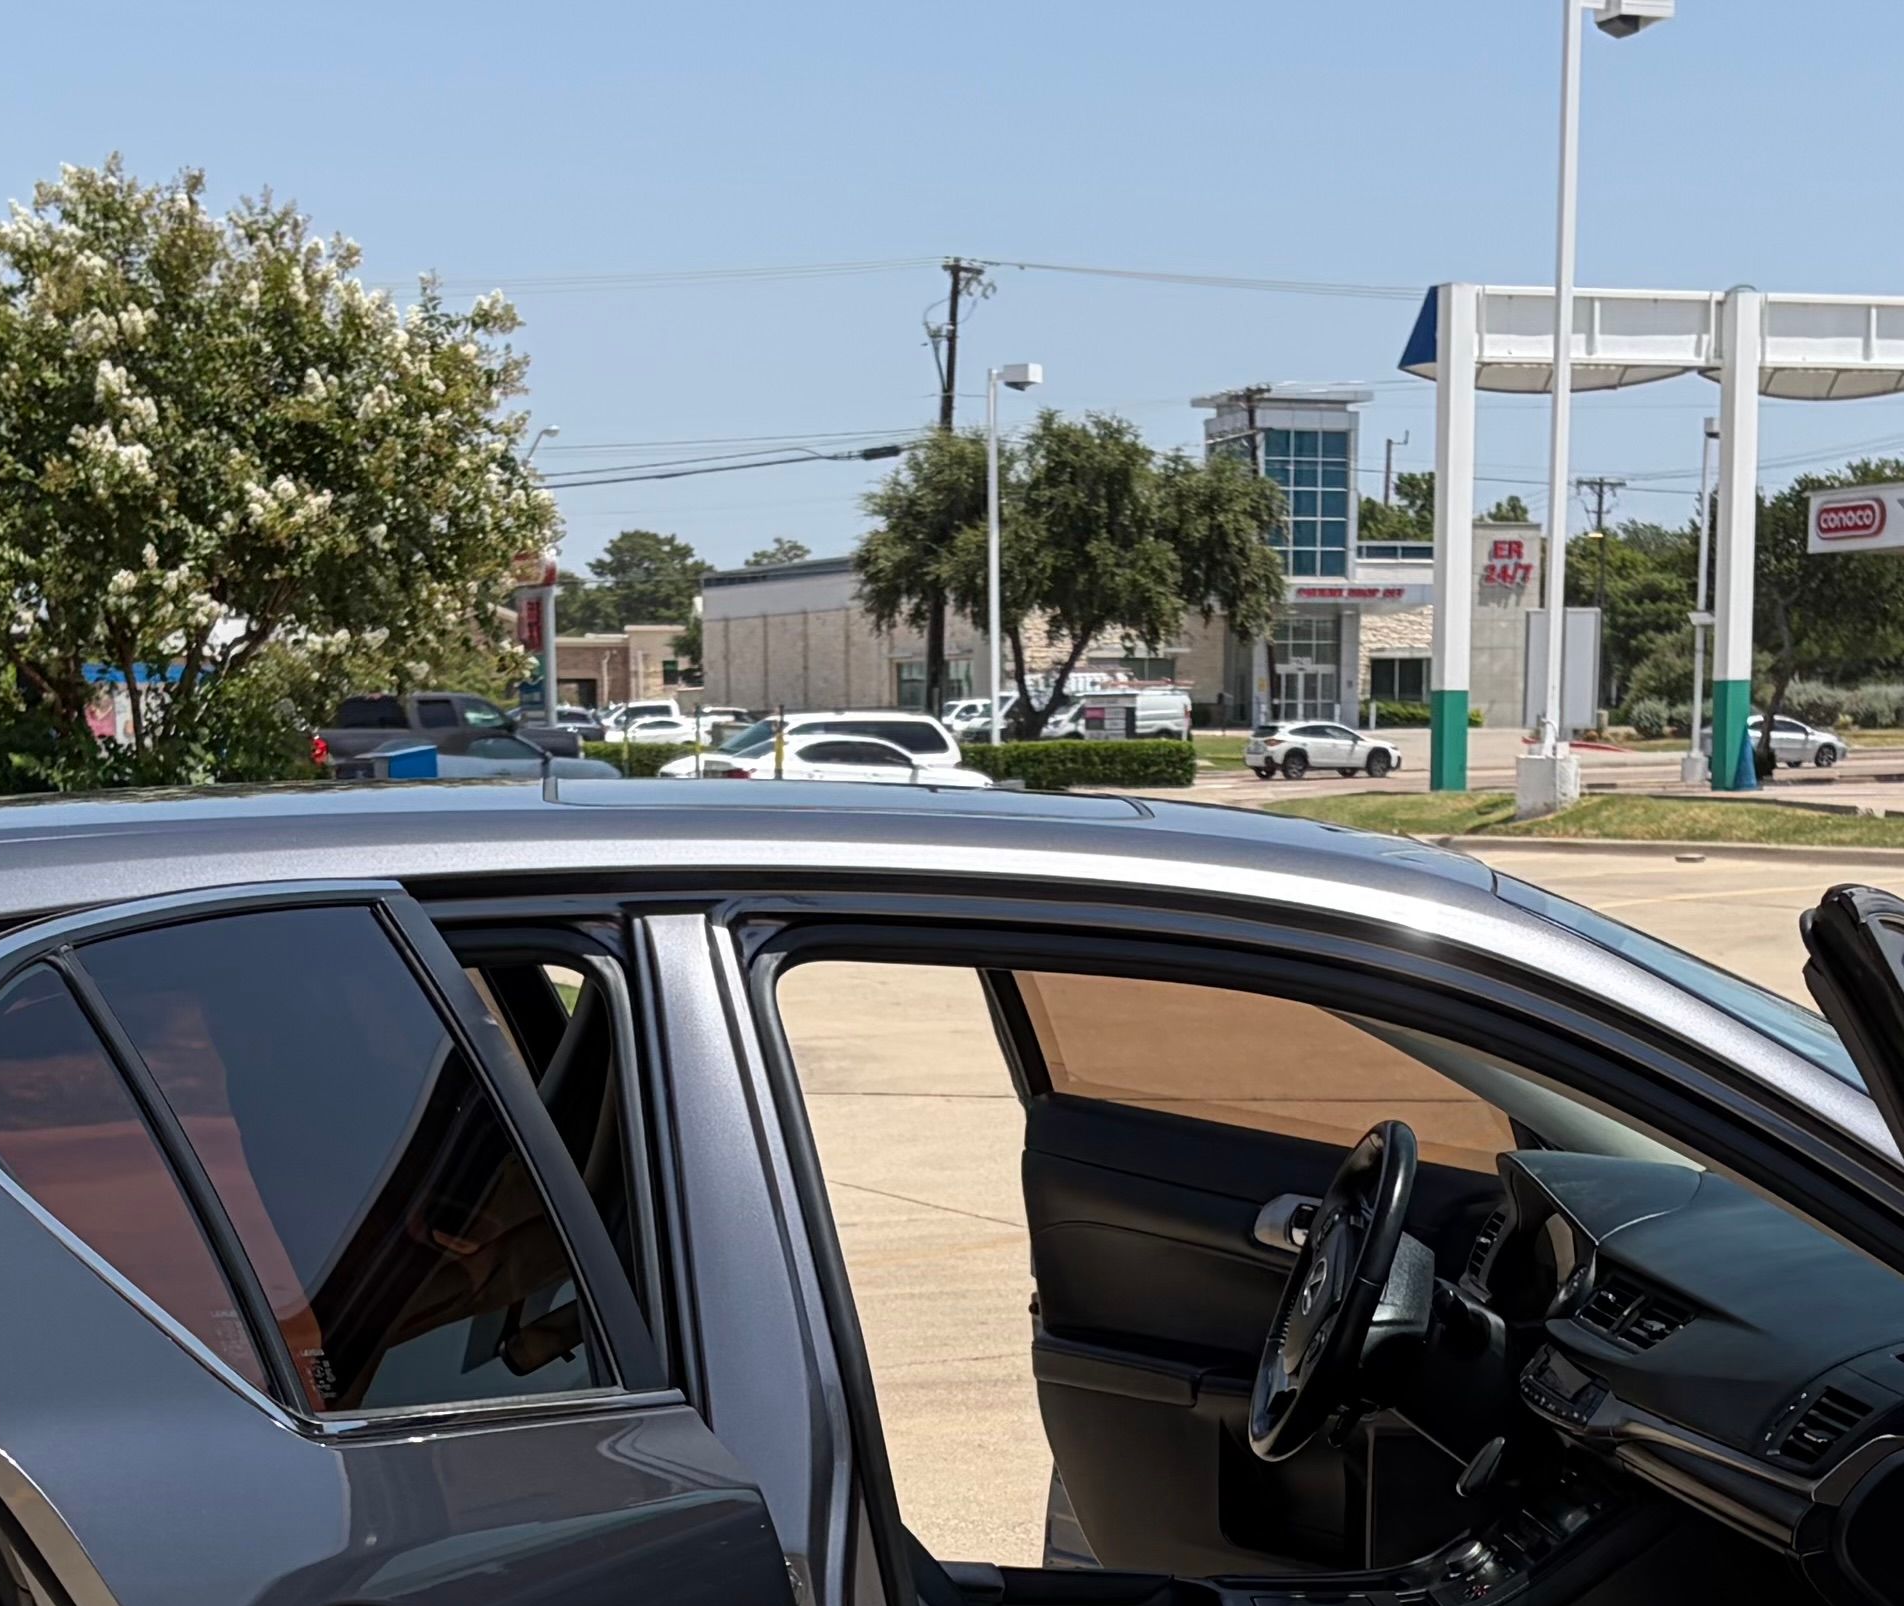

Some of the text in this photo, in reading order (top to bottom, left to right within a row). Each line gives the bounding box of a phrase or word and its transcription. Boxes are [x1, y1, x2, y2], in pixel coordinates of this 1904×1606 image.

[1819, 508, 1873, 529] conoco
[1493, 540, 1525, 559] ER
[1484, 563, 1534, 585] 24/7
